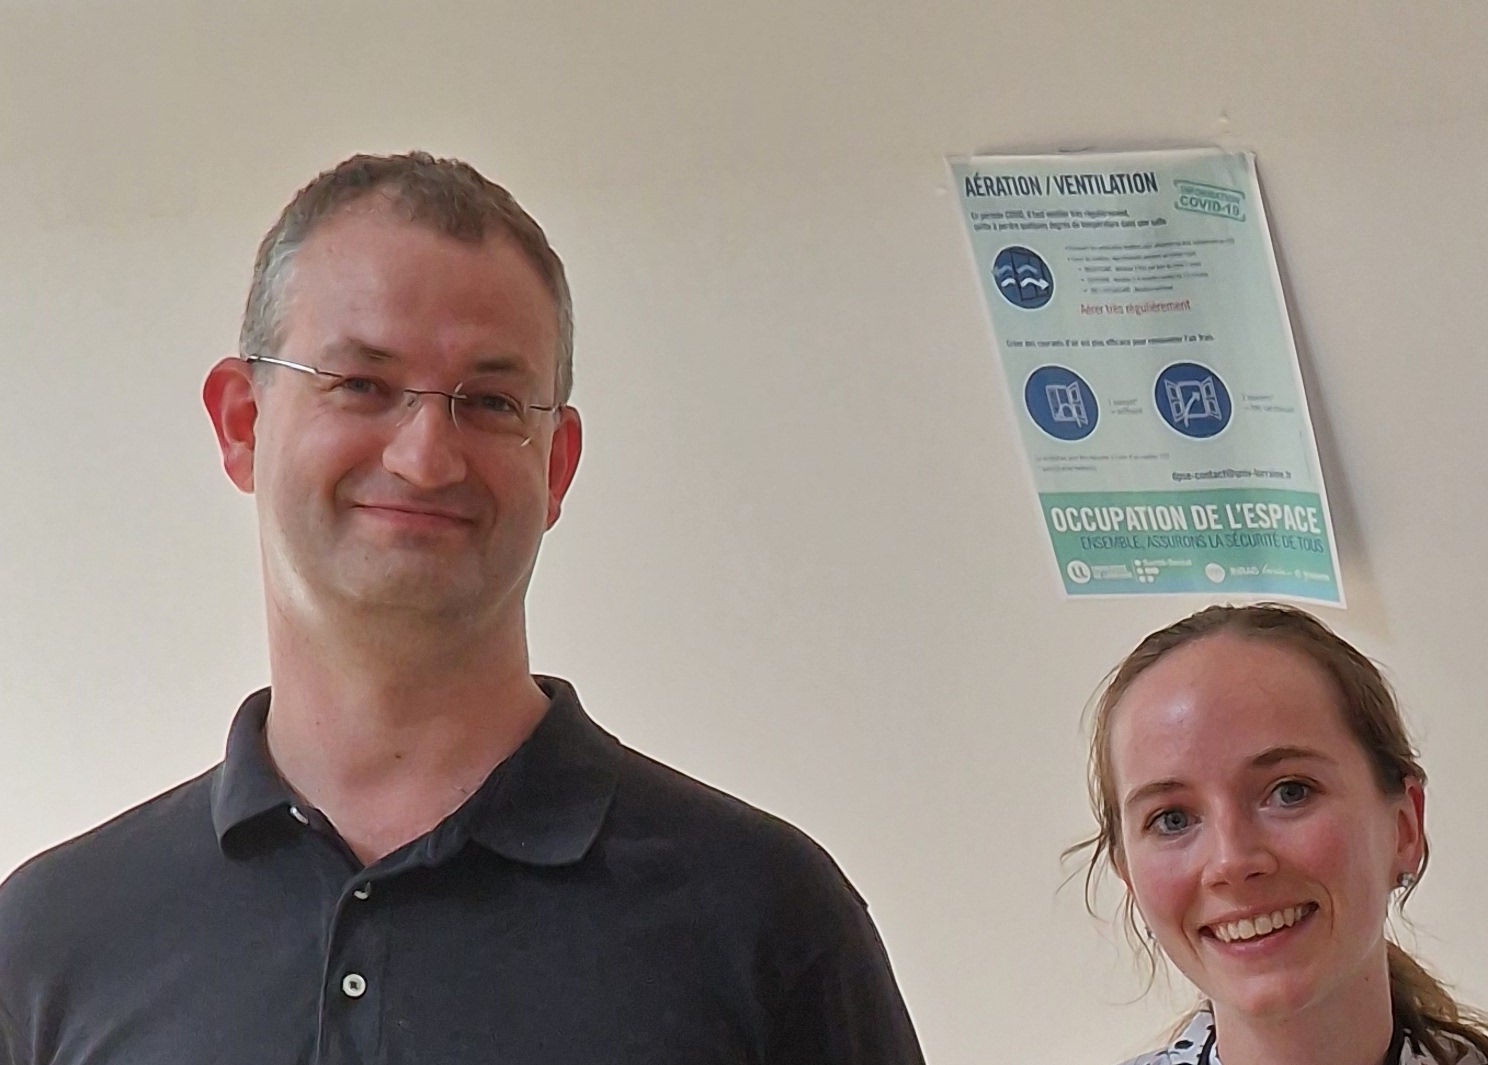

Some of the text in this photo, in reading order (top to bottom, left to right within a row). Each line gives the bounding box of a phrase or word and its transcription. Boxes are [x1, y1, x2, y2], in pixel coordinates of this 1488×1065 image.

[965, 172, 1042, 196] AÉRATION
[1053, 172, 1158, 195] VENTILATION
[1051, 503, 1322, 533] OCCUPATION DE L'ESPACE
[1147, 534, 1207, 550] ASSURONS
[1209, 534, 1224, 549] LA
[1283, 536, 1298, 551] DE
[1298, 536, 1325, 554] TOUS
